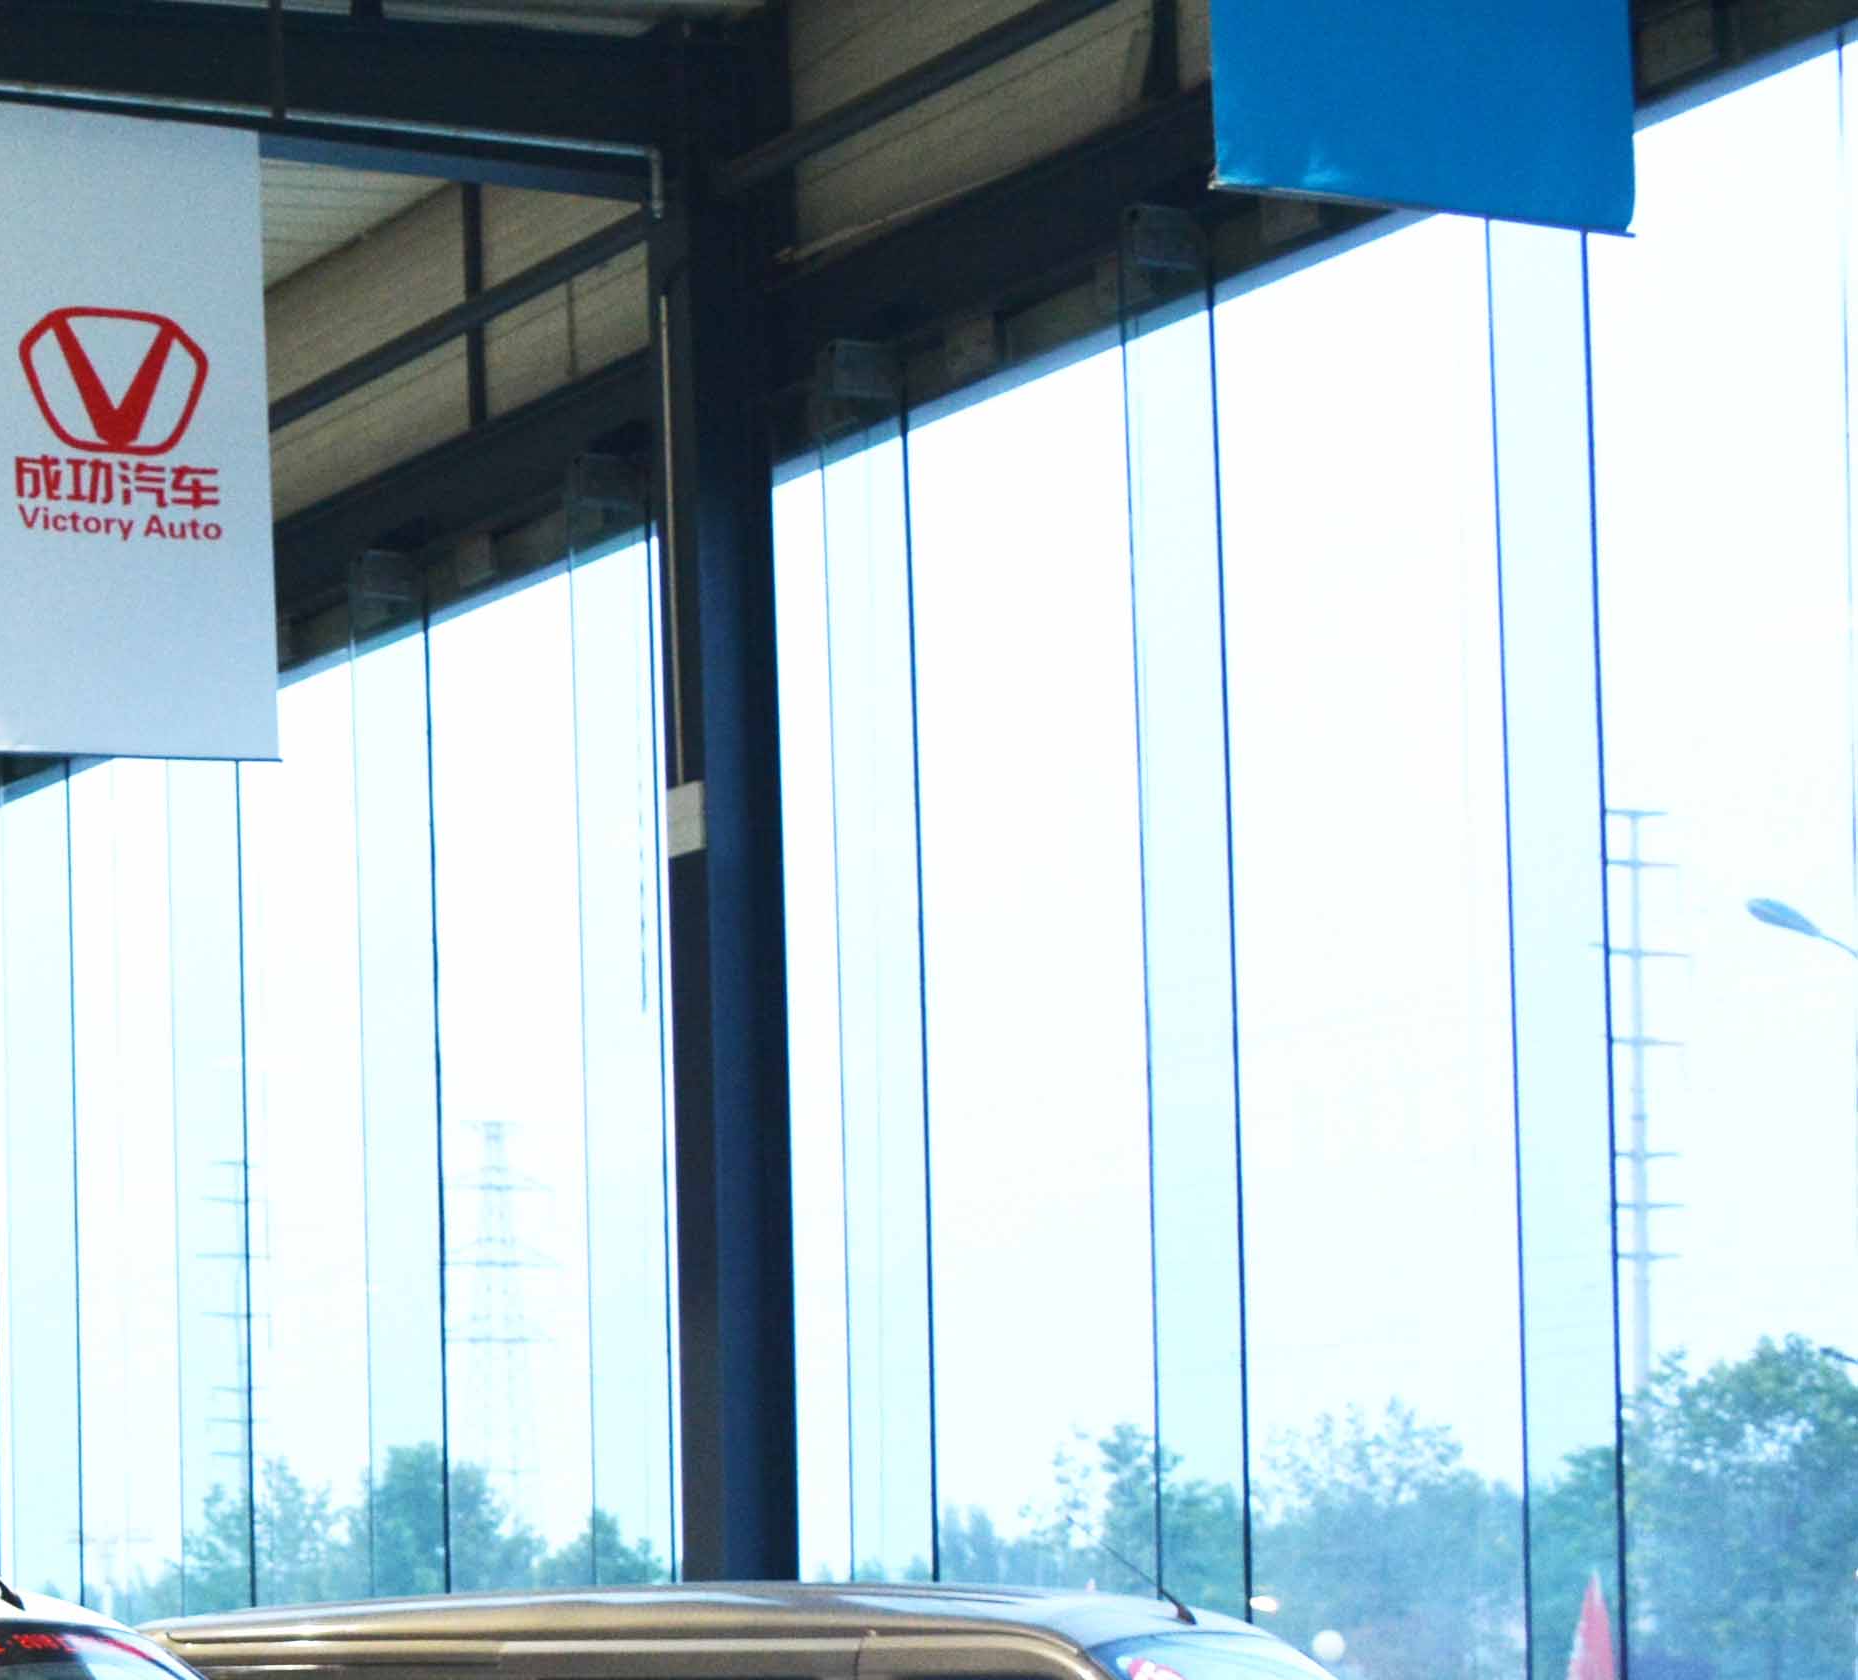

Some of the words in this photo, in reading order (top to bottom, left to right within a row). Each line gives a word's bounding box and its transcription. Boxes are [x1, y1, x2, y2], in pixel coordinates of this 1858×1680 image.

[14, 456, 219, 509] 成功汽车
[18, 504, 133, 540] Victory
[144, 510, 223, 540] Auto
